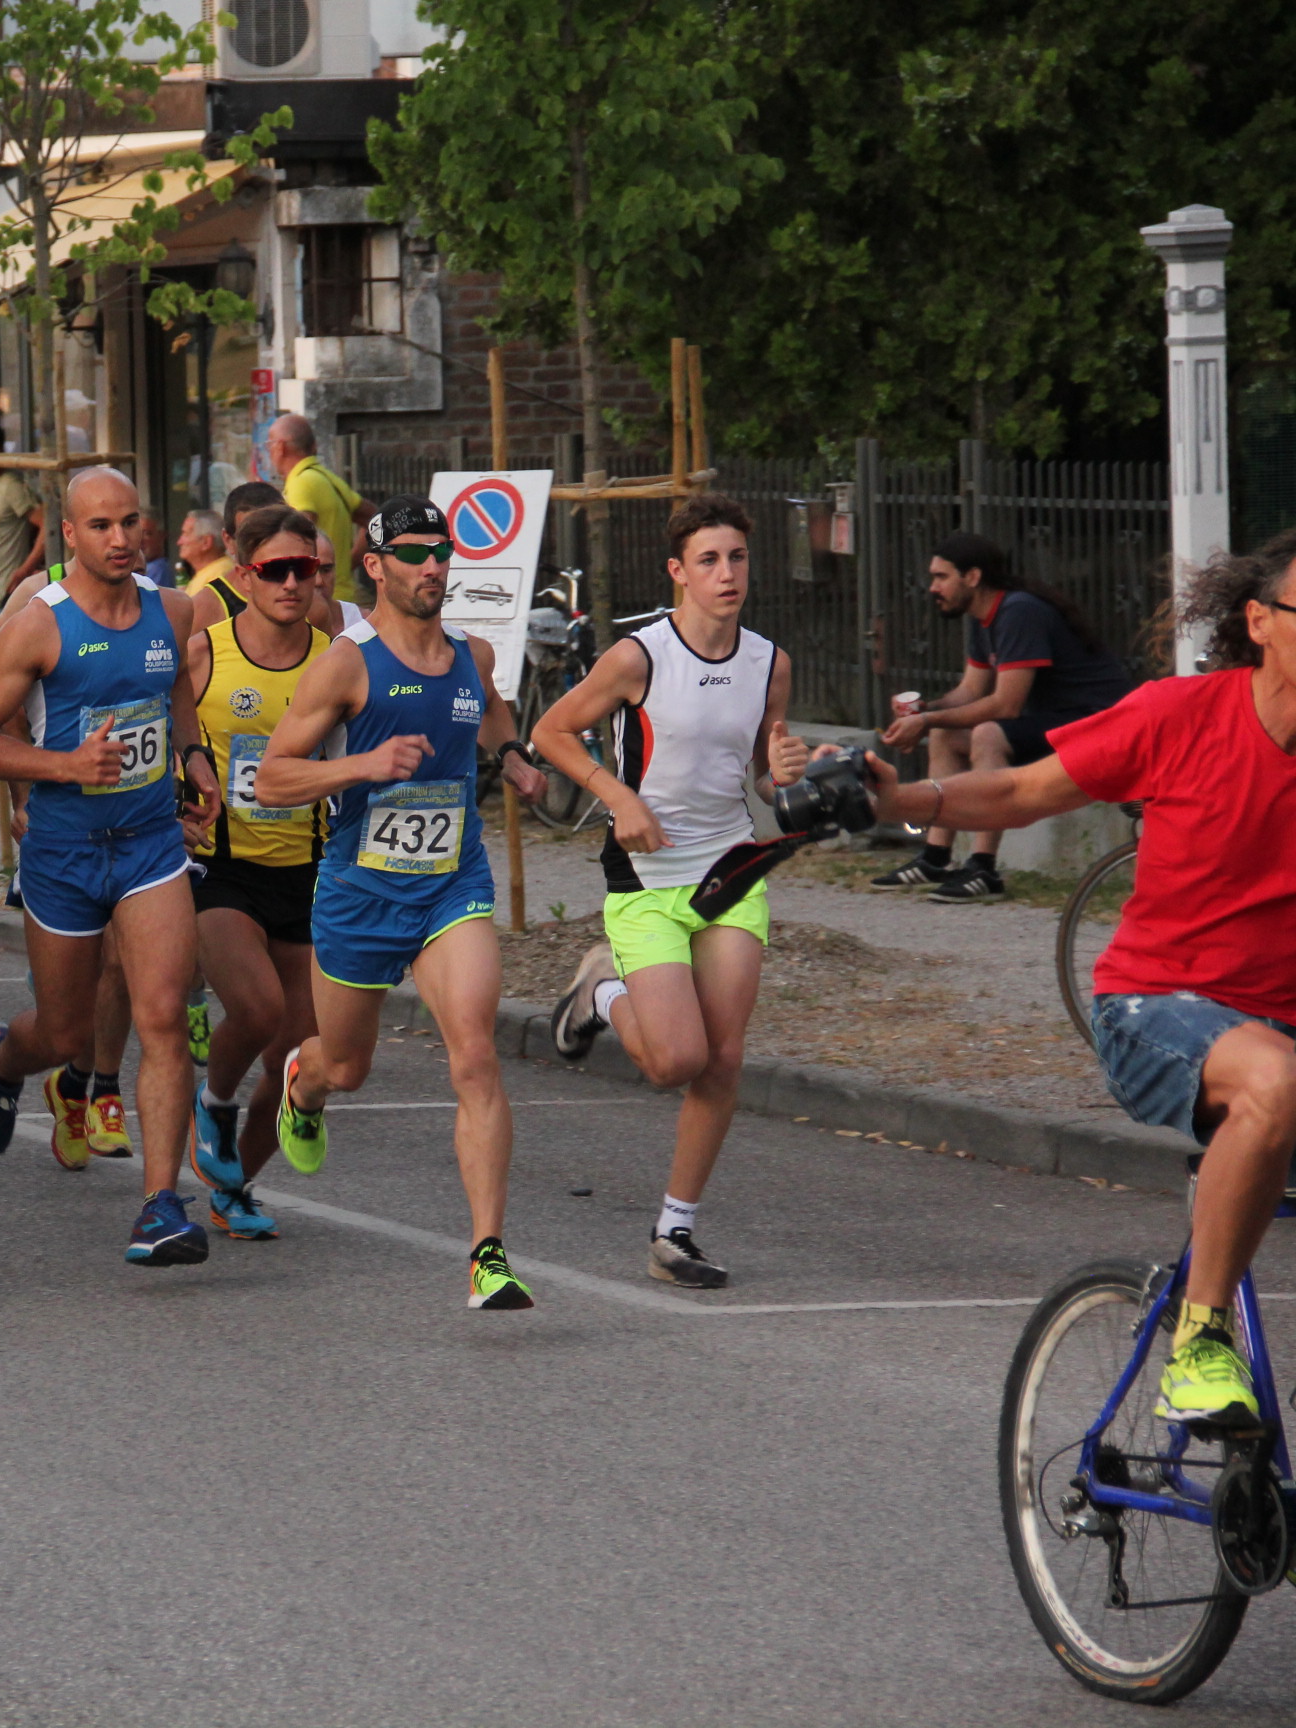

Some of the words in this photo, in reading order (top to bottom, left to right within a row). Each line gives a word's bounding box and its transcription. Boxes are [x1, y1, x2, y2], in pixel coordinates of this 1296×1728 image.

[150, 640, 166, 649] G.P.
[458, 687, 473, 698] G.P.
[106, 727, 157, 771] 56
[373, 812, 451, 853] 432
[384, 856, 421, 871] HOKA
